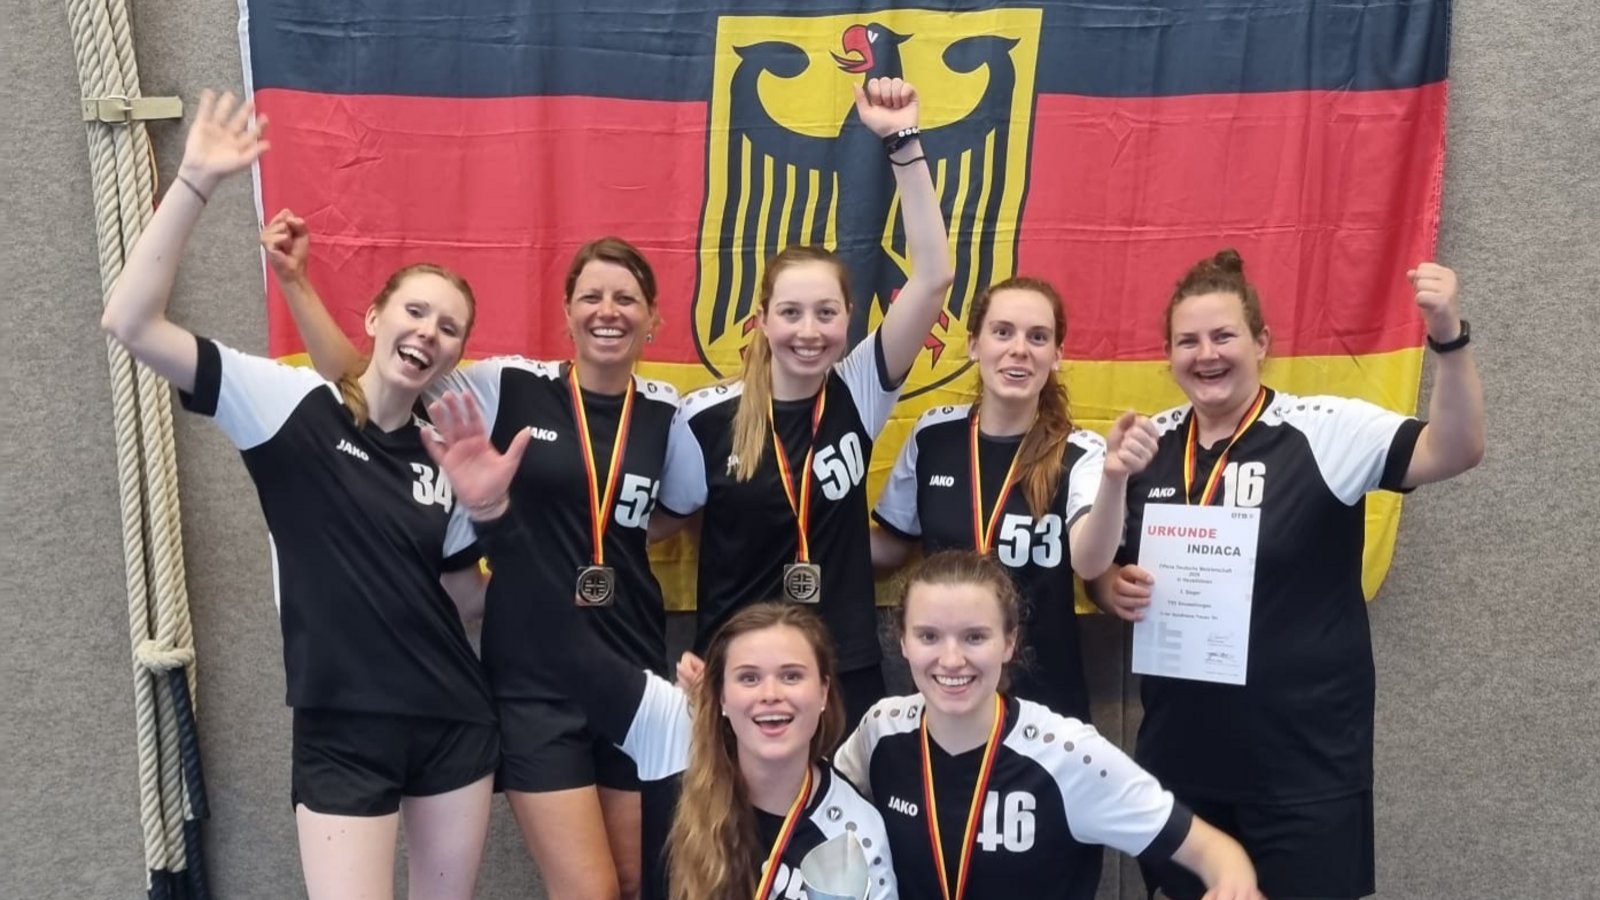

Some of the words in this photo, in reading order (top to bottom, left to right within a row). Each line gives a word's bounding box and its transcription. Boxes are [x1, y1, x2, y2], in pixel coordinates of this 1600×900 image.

[530, 426, 558, 441] AKO
[336, 438, 369, 461] JAKO
[812, 431, 865, 501] 50
[409, 462, 453, 514] 34
[929, 475, 955, 487] JAKO
[1222, 461, 1266, 508] 16
[1147, 487, 1176, 499] JAKO
[998, 513, 1063, 568] 53
[1147, 525, 1218, 539] URKUNDE
[1187, 544, 1242, 557] INDIACA
[888, 795, 919, 817] JAKO
[976, 790, 1036, 852] 46
